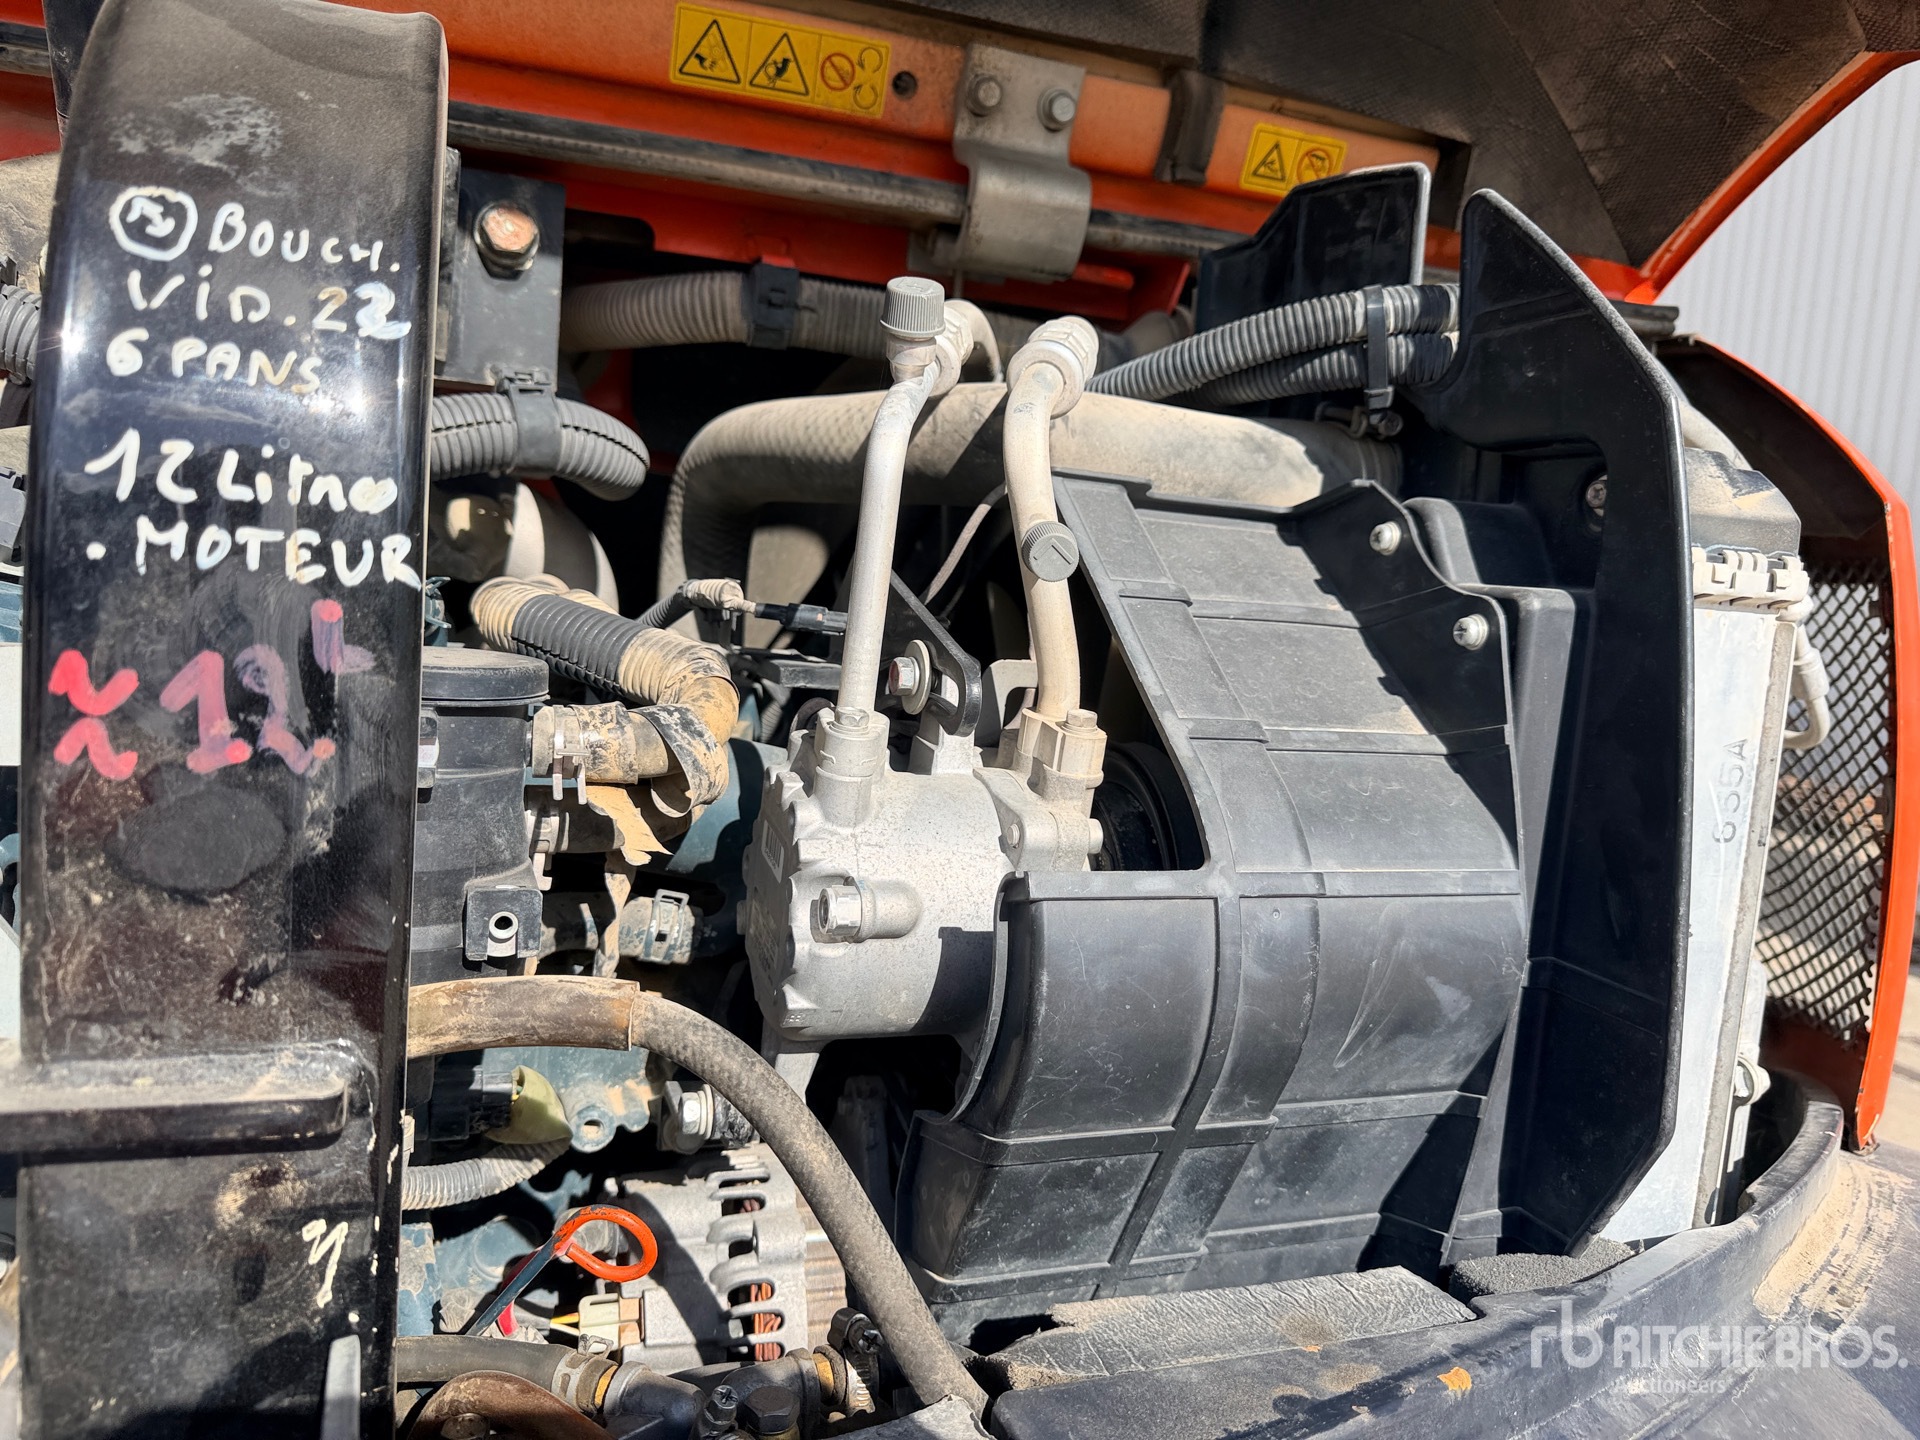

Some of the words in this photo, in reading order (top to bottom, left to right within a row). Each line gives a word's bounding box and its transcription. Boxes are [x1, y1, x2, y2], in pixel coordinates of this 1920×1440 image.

[106, 327, 149, 376] 6
[171, 337, 322, 393] PANS
[135, 515, 422, 591] MOTEUR
